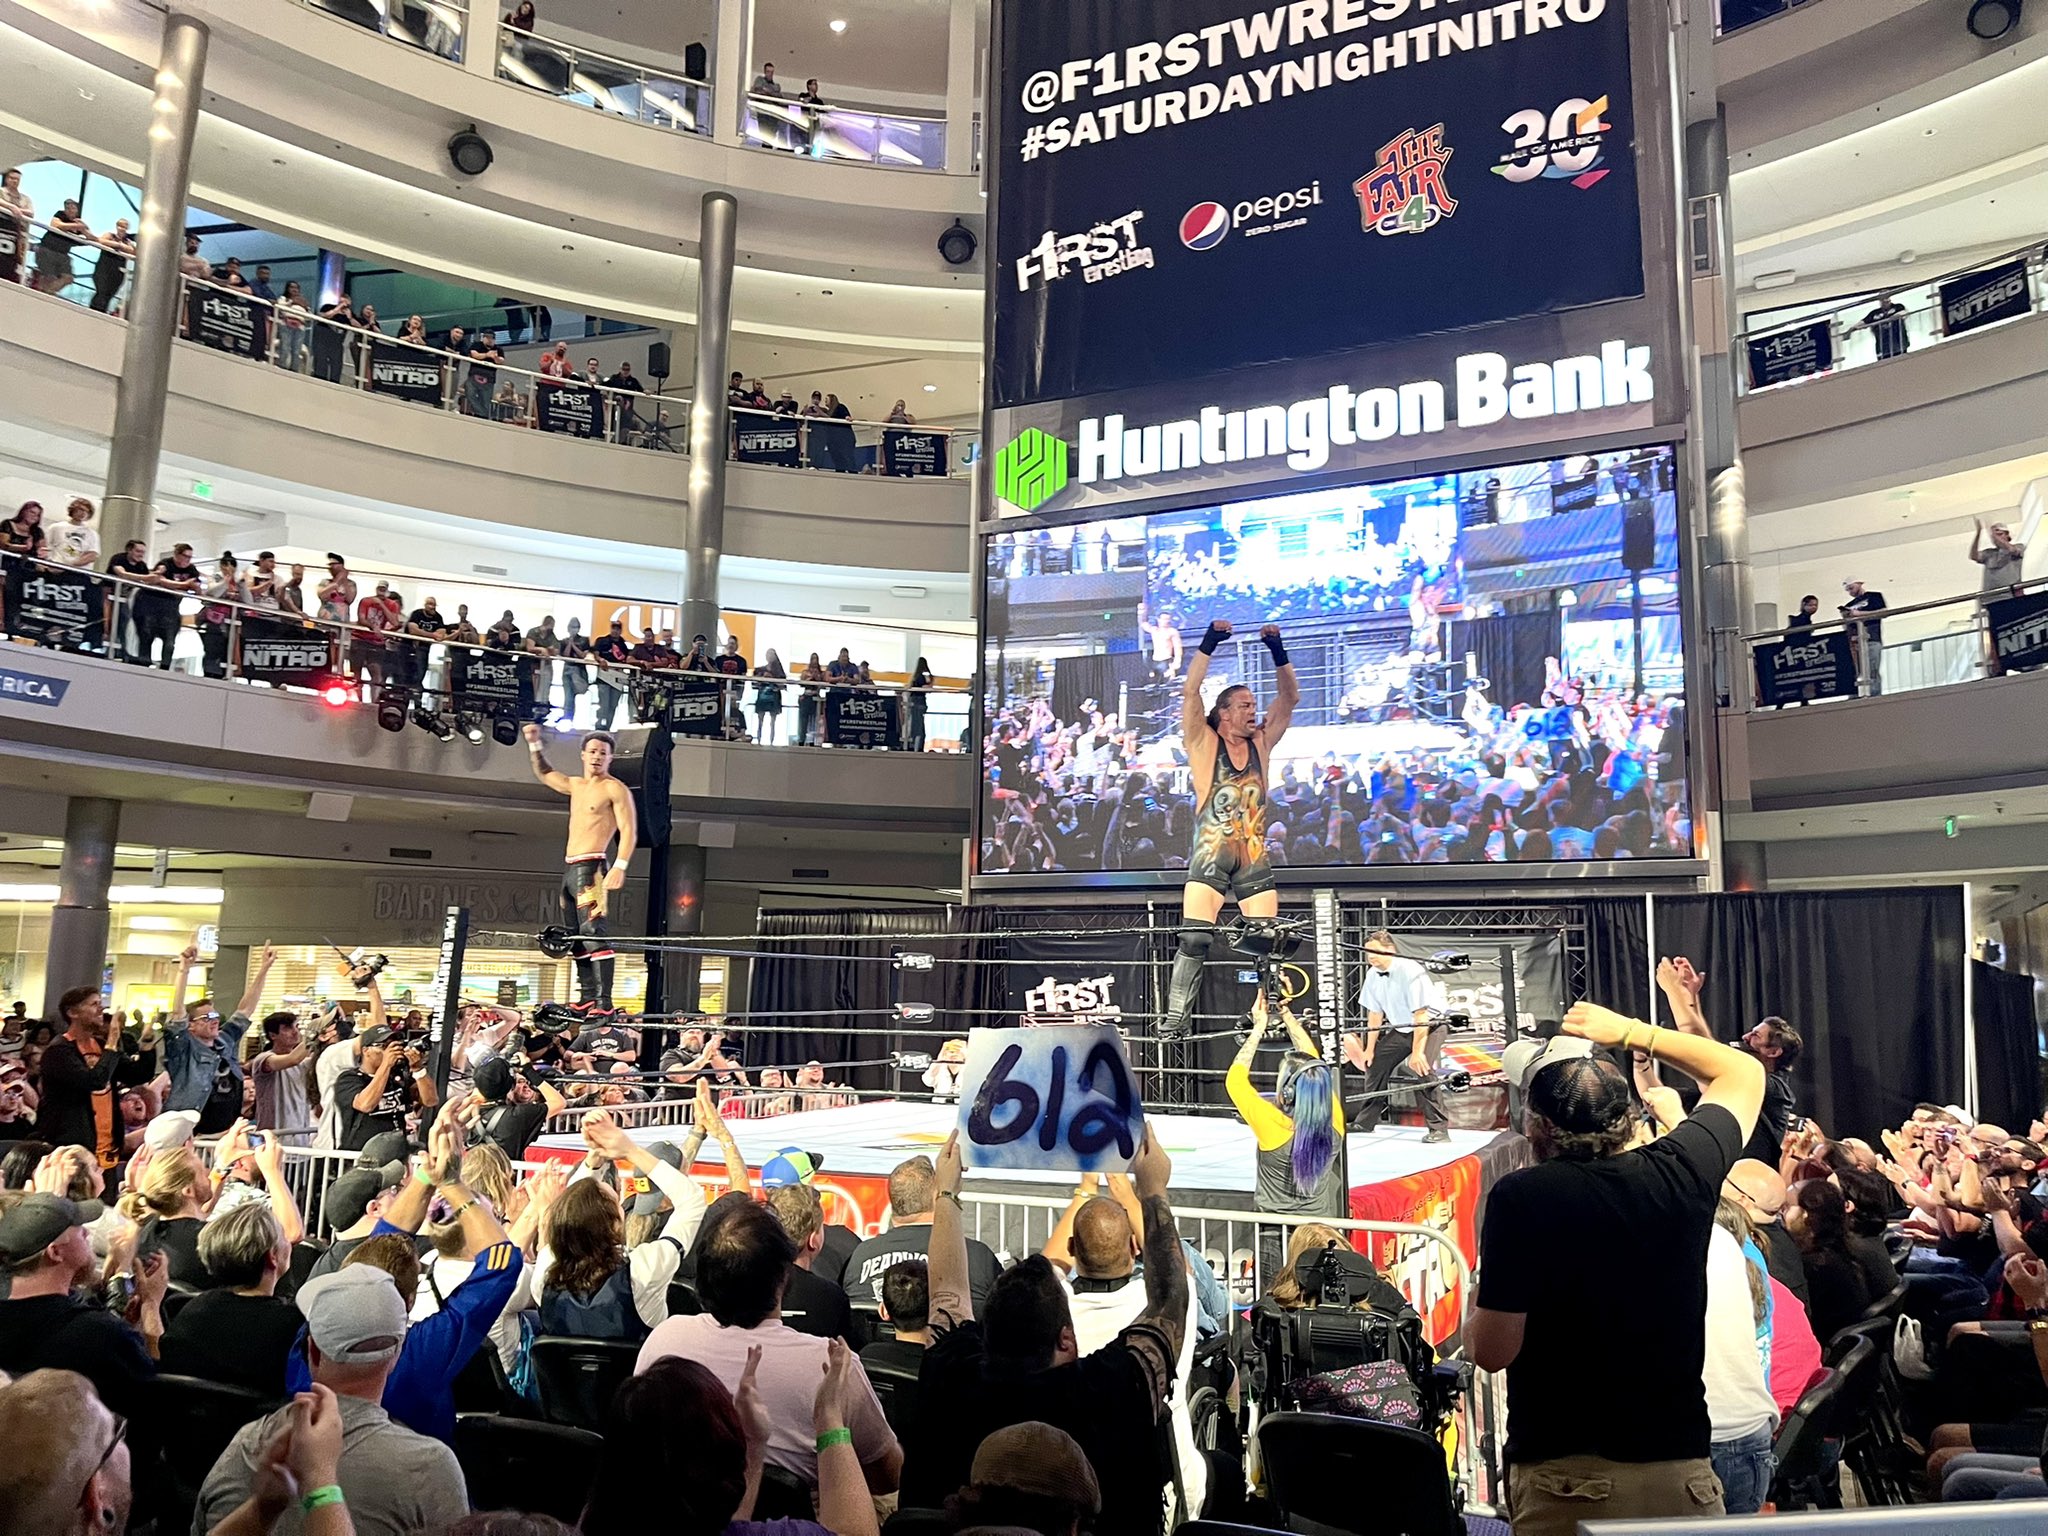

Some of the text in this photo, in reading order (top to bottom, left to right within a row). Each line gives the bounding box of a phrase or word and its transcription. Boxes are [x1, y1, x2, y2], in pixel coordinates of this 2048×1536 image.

[1021, 0, 1453, 114] @F1RSTWRES
[1020, 0, 1605, 161] #SATURDAYNIGHTNITRO
[1377, 126, 1450, 176] THE
[1531, 144, 1547, 156] OF
[1550, 135, 1603, 151] AMERICA
[1232, 180, 1320, 228] pepsi
[1357, 159, 1455, 228] FAIR
[1402, 195, 1431, 229] 4
[1016, 209, 1145, 292] F1RST
[1948, 279, 2024, 325] NITRO
[372, 367, 439, 386] NITRO
[548, 389, 590, 405] F1RST
[1077, 339, 1653, 473] Huntington Bank
[739, 437, 797, 450] NITRO
[895, 435, 932, 450] F1RST
[22, 577, 86, 601] F1RST
[1773, 638, 1830, 669] F1RST
[1998, 620, 2048, 657] NIT
[243, 650, 328, 667] NITRO
[466, 660, 517, 680] F1RST
[0, 675, 56, 699] RICA
[673, 701, 718, 717] TRO
[839, 697, 885, 716] F1RST
[1314, 893, 1337, 1030] @F1RSTWRESTLING
[1024, 974, 1116, 1014] F1RST
[966, 1041, 1135, 1161] 612
